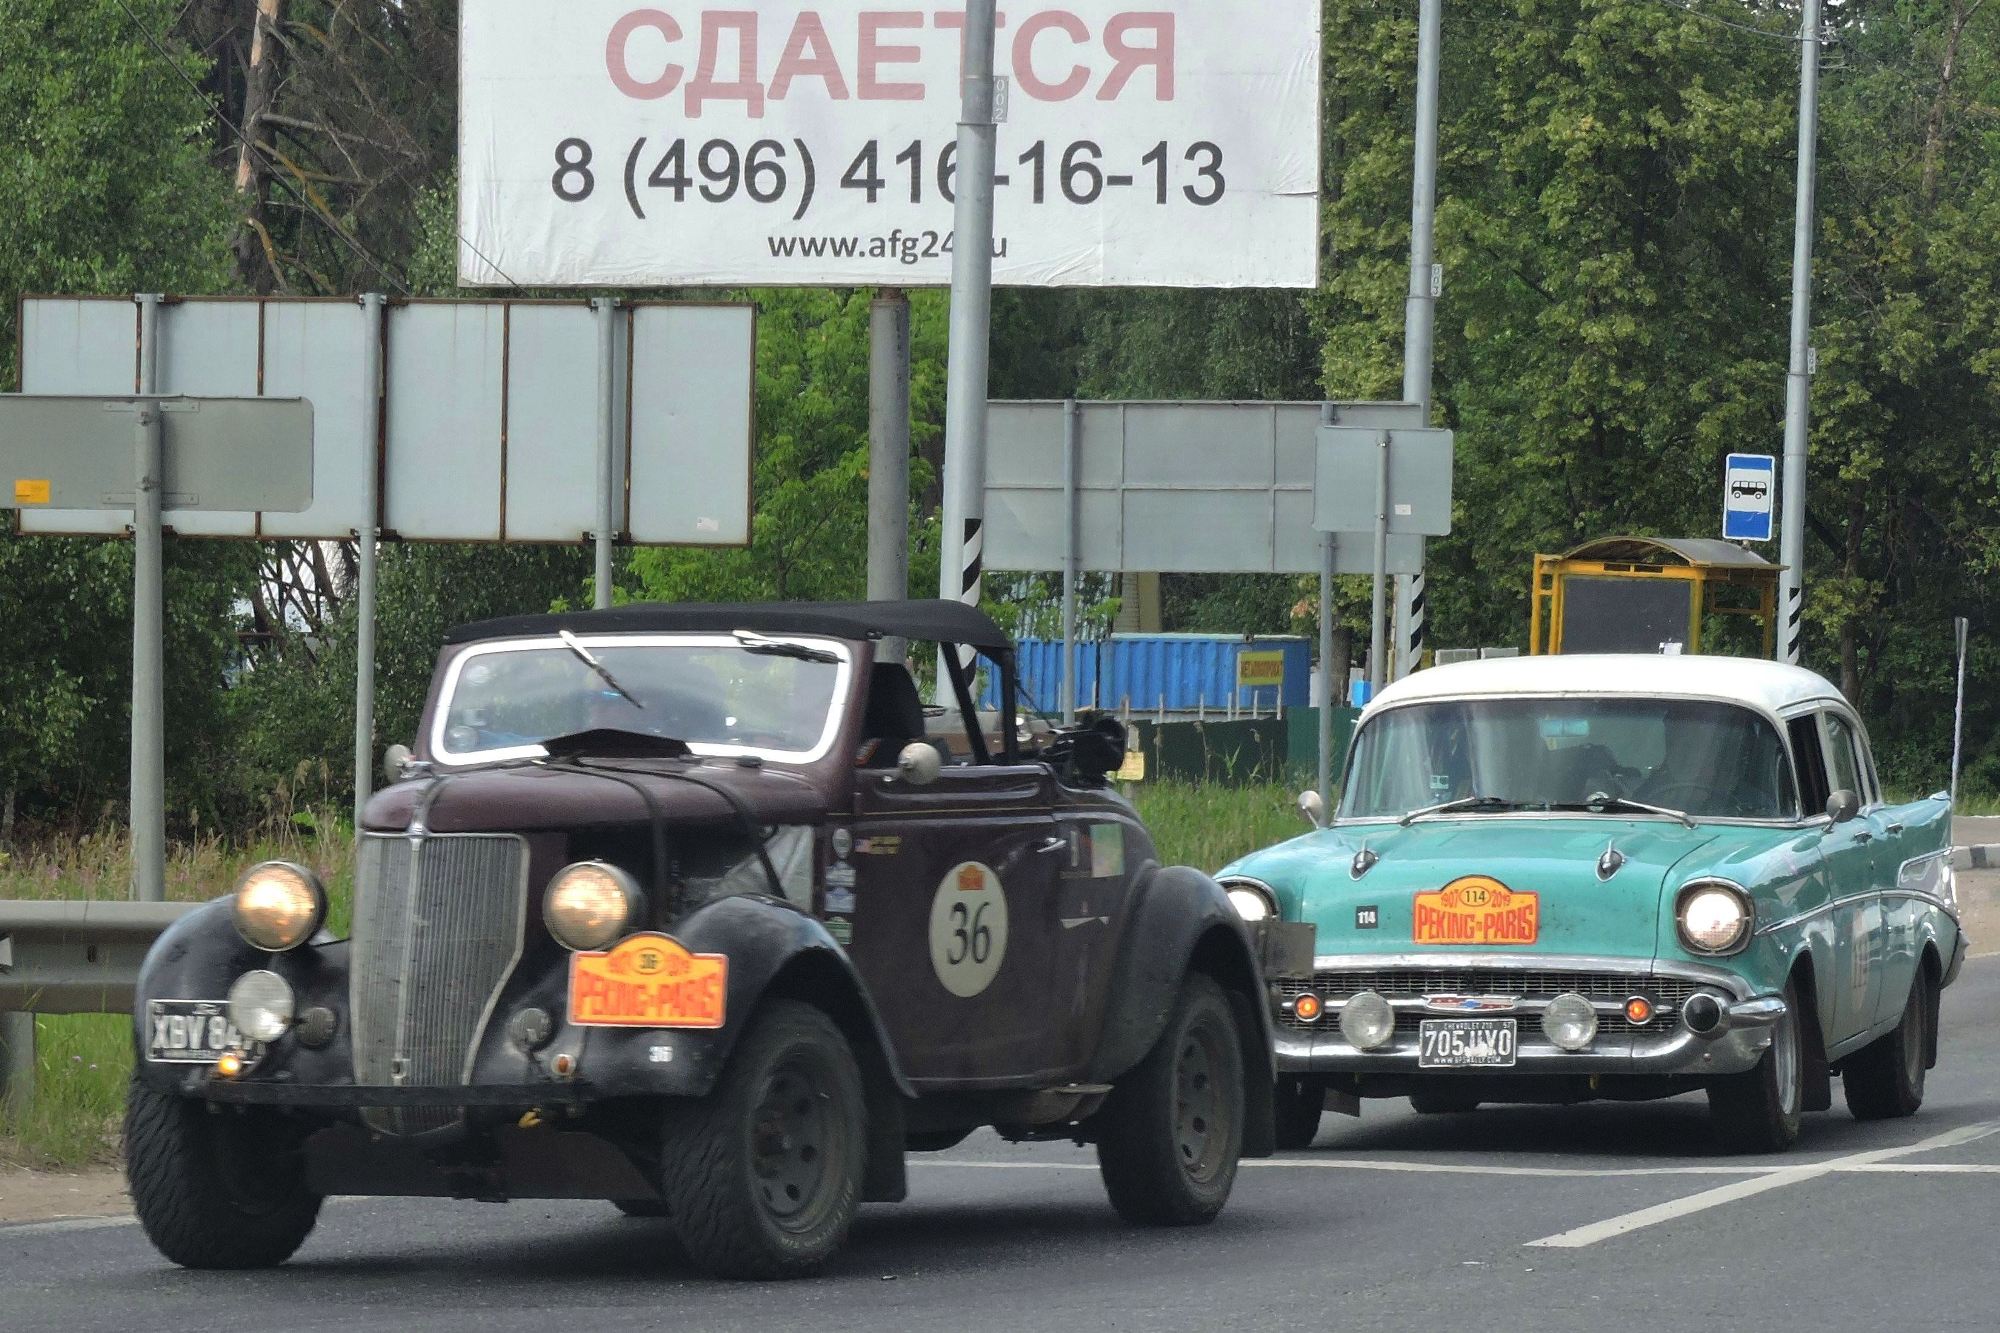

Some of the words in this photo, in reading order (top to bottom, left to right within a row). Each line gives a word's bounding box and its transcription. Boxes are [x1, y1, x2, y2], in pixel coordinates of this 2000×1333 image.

[552, 138, 594, 203] 8
[624, 138, 815, 220] (496)
[768, 229, 1007, 265] www.afg24u
[1465, 891, 1486, 903] 114
[947, 901, 991, 965] 36
[1358, 911, 1376, 924] 114
[1417, 903, 1533, 940] PEKING-PARIS
